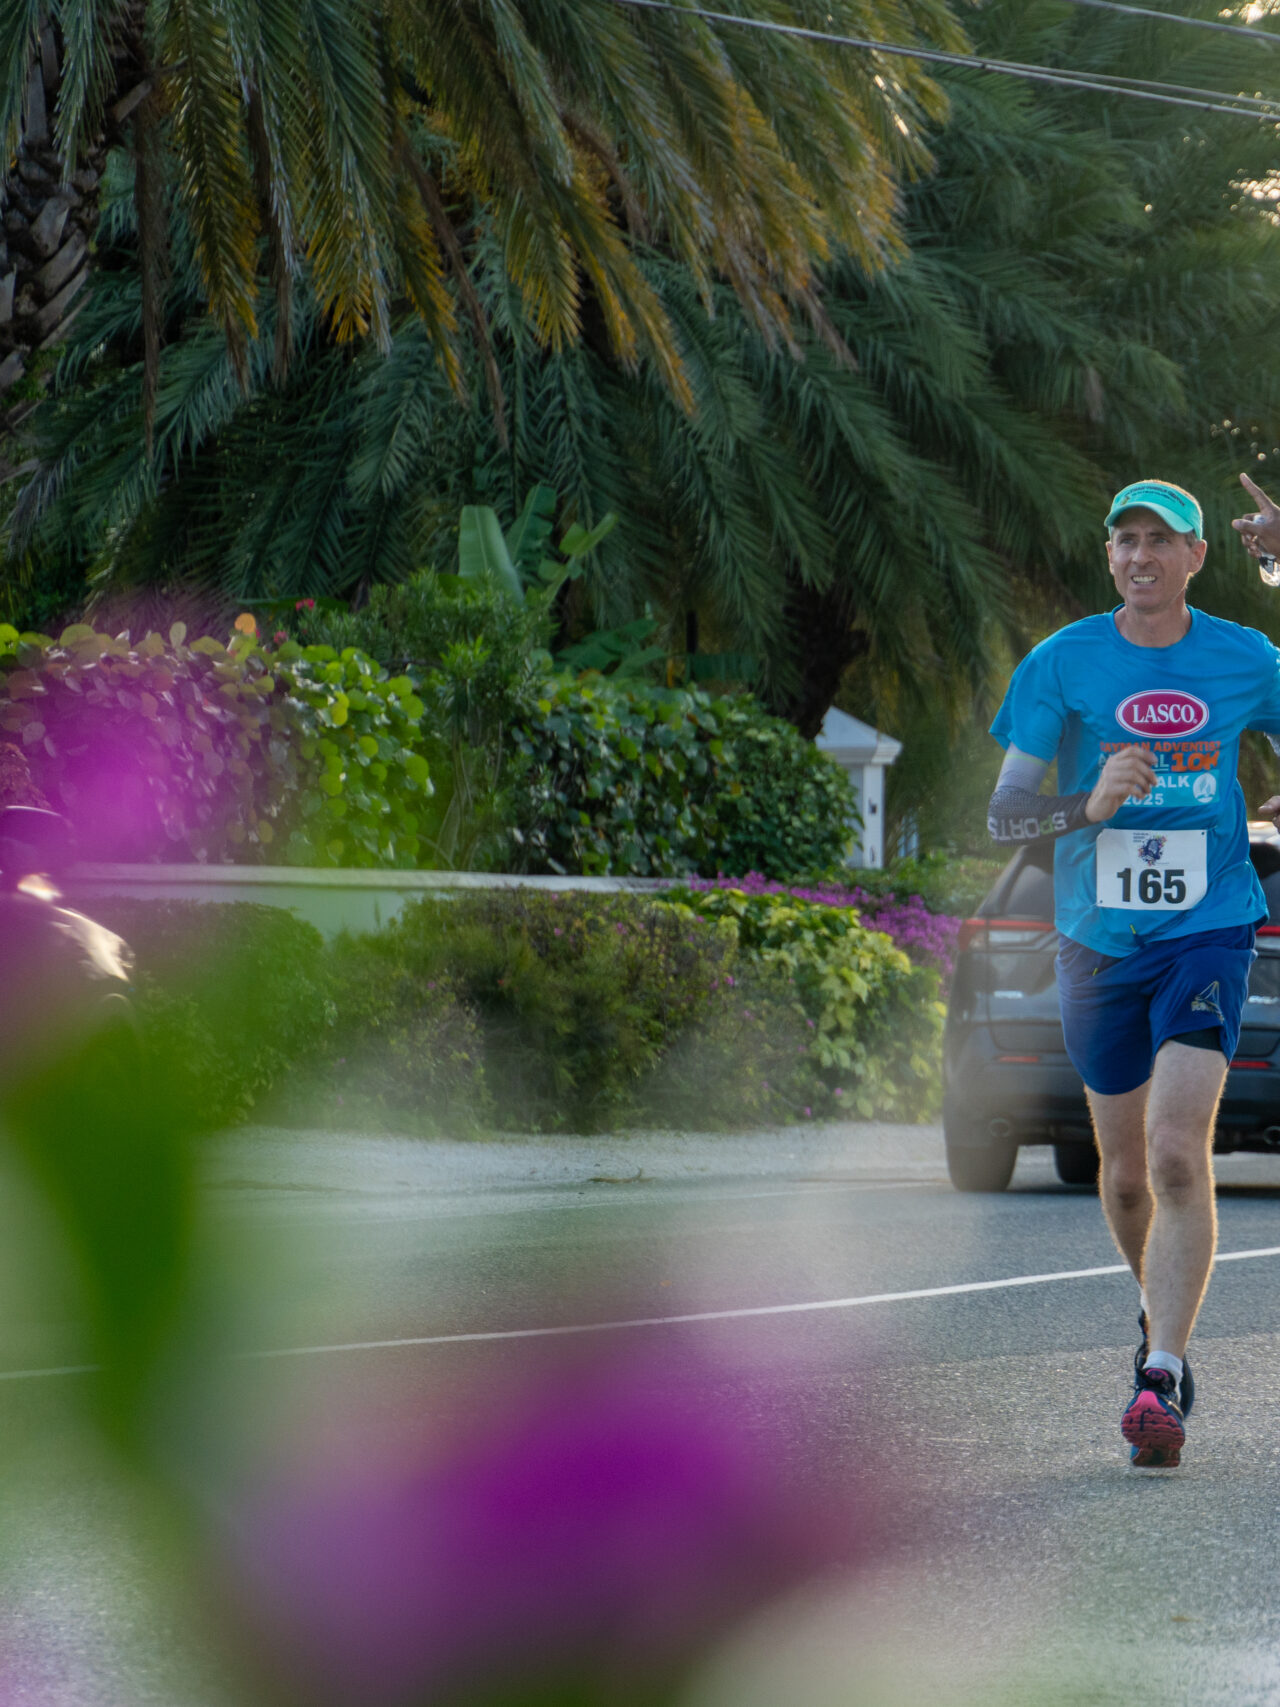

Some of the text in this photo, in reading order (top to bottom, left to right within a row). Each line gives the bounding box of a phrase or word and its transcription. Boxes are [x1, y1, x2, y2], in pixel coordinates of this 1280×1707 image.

[1132, 704, 1196, 723] LASCO
[1171, 751, 1220, 772] 10K
[1156, 775, 1190, 788] ALK
[987, 811, 1068, 841] SPORTS
[1116, 867, 1187, 904] 165
